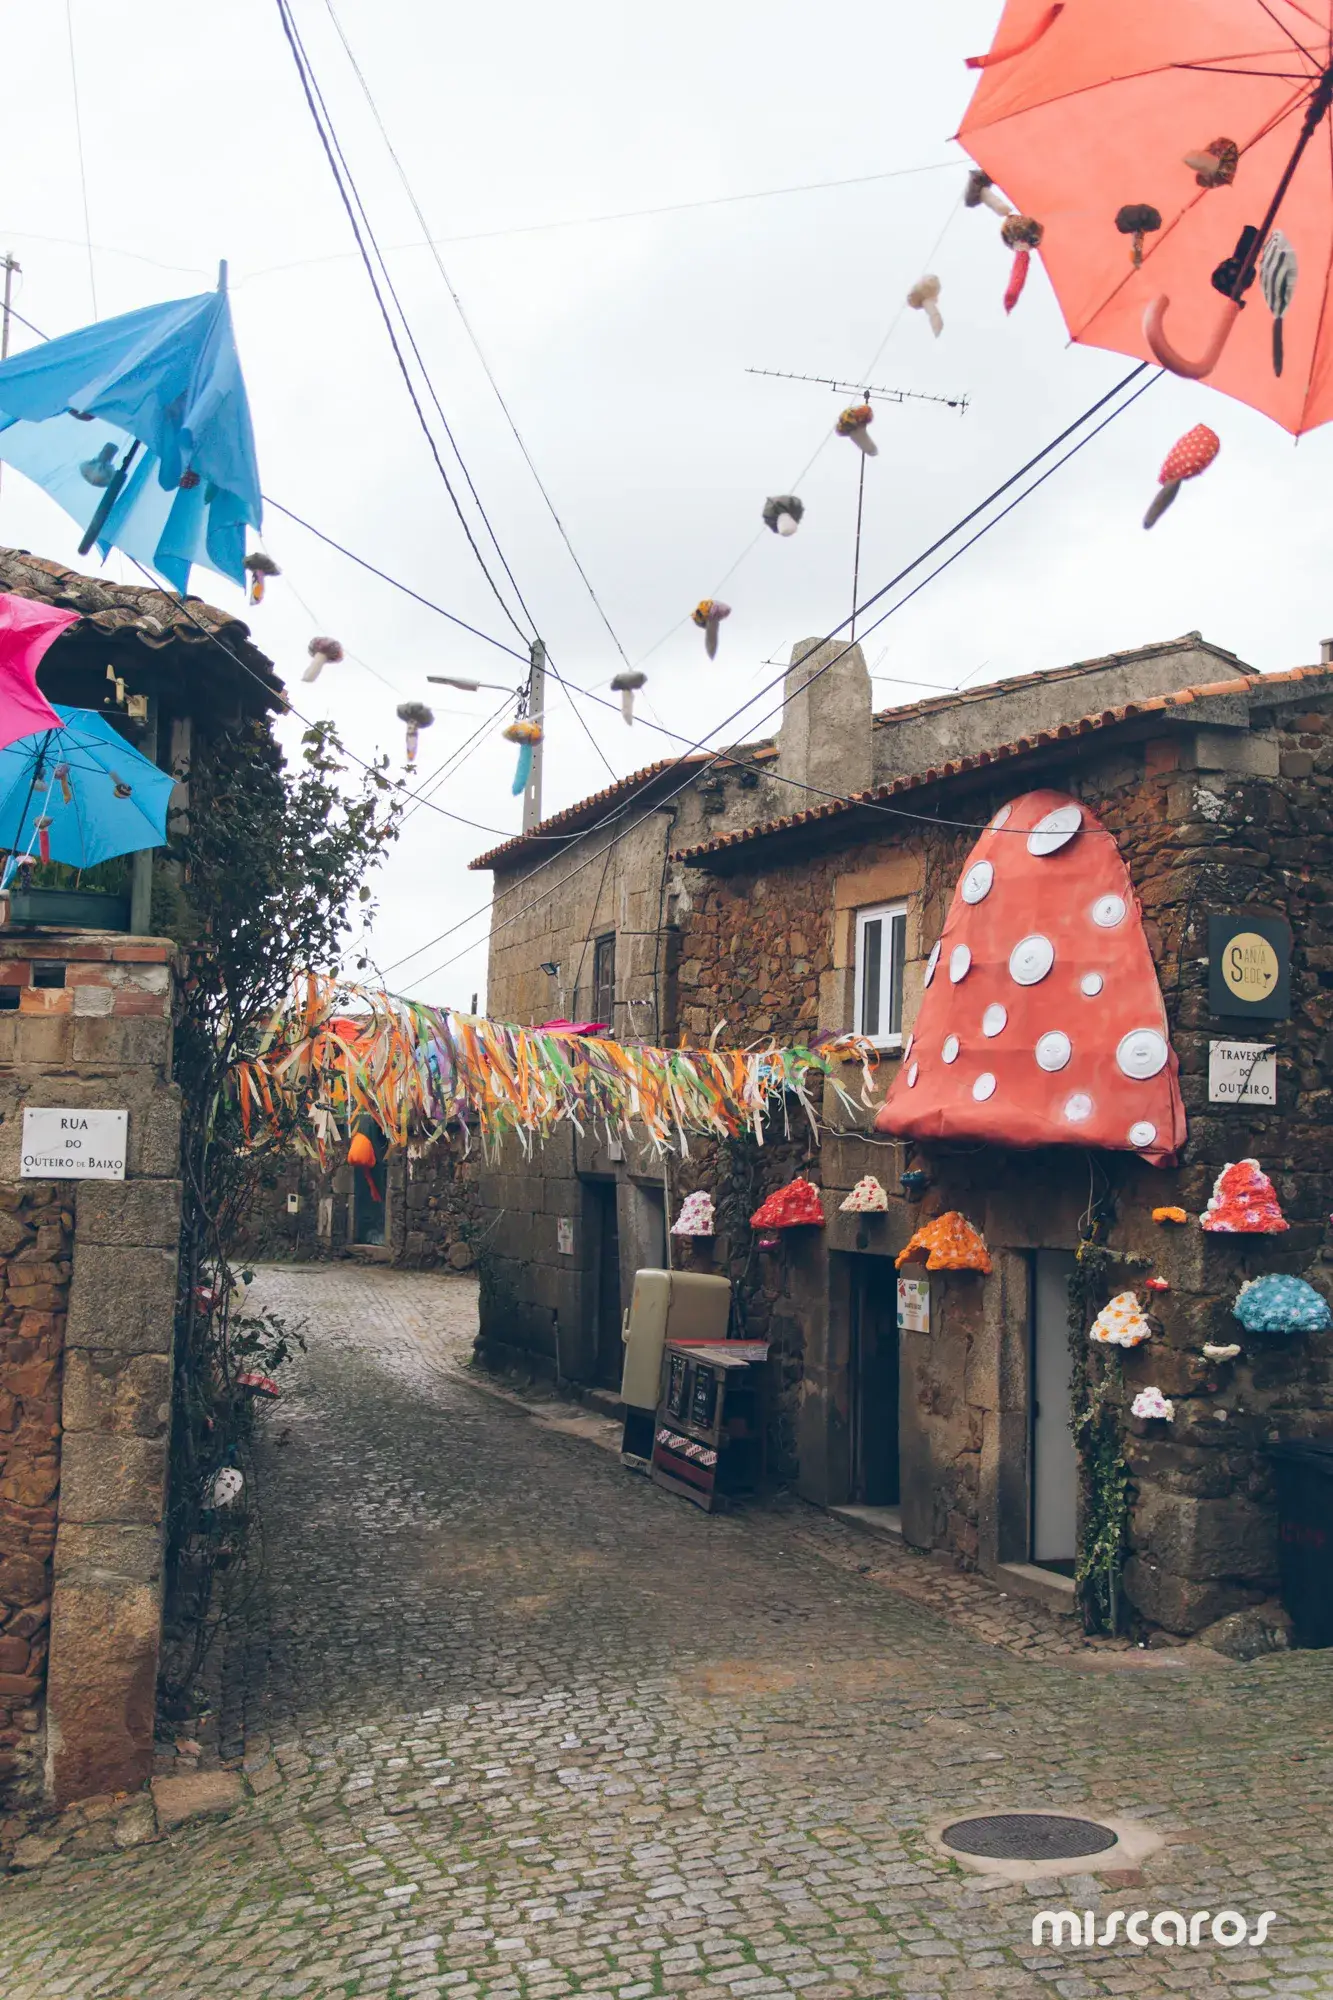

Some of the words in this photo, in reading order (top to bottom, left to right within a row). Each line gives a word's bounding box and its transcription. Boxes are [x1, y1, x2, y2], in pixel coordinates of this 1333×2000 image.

[1220, 1049, 1268, 1062] TRAVESSA
[1239, 1068, 1251, 1077] DO
[1219, 1083, 1270, 1095] OUTEIRO
[60, 1118, 88, 1130] RUA
[65, 1139, 82, 1149] DO
[23, 1155, 74, 1168] OUTEIRO
[88, 1157, 123, 1169] BAIXO
